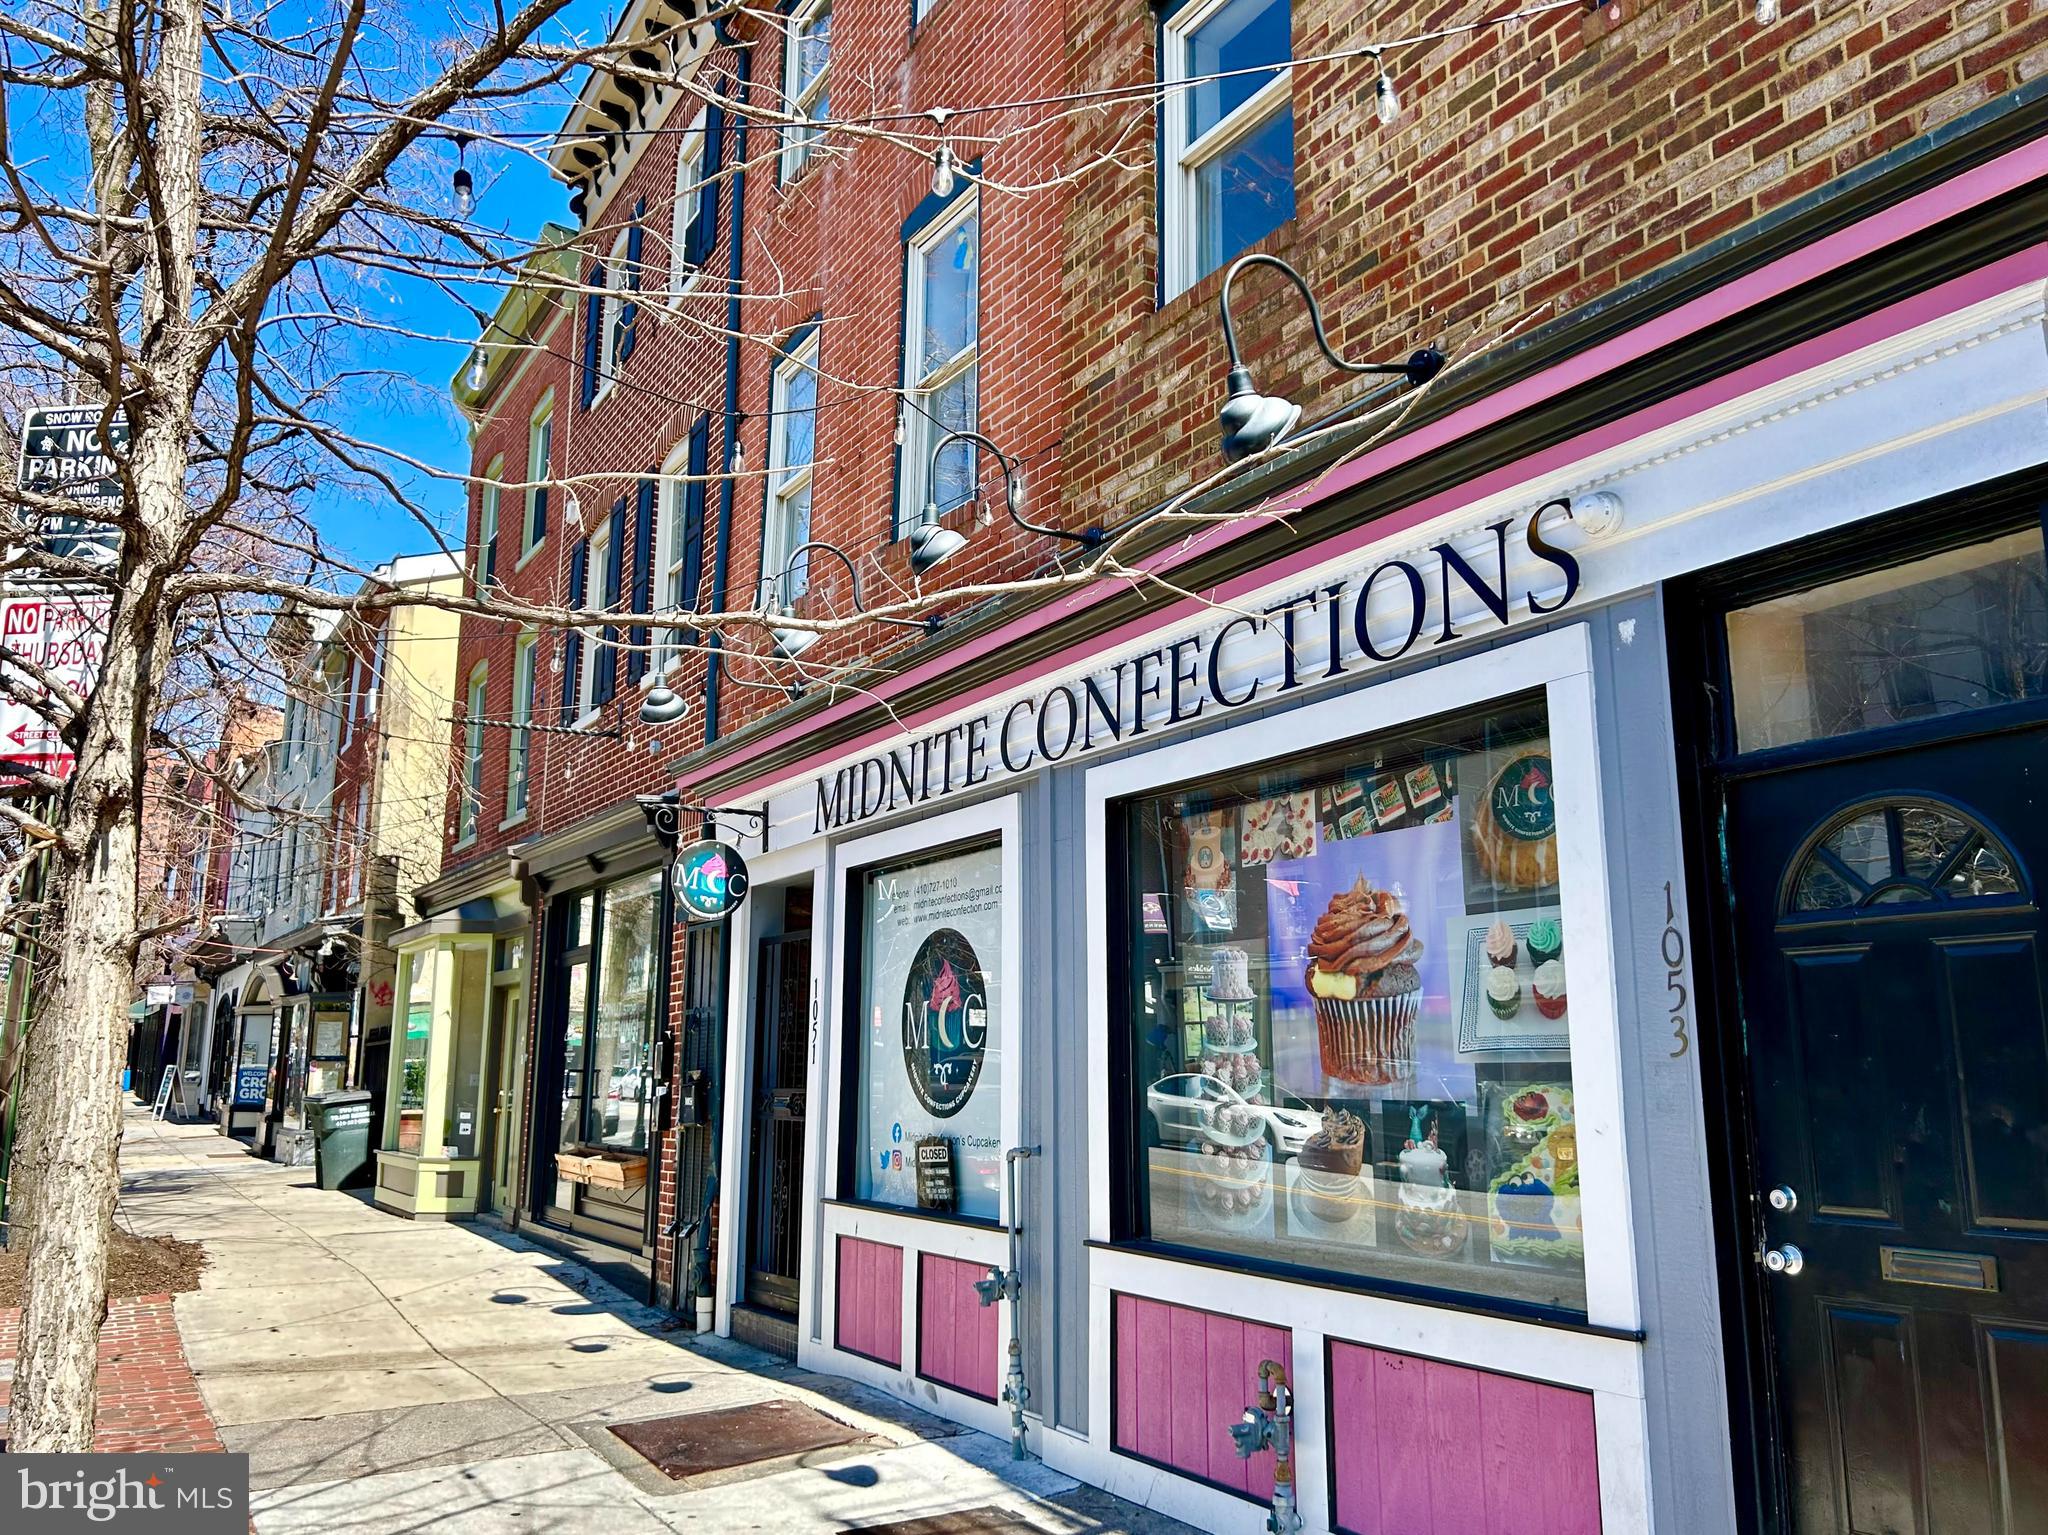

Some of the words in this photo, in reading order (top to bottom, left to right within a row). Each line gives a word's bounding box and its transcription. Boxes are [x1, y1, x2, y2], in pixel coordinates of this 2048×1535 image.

[45, 411, 83, 425] SNOW
[84, 409, 128, 423] ROTE
[28, 455, 118, 480] PARKIN
[8, 607, 38, 633] NO
[812, 715, 989, 835] MIDNITE
[1000, 497, 1580, 774] CONFECTIONS
[14, 731, 44, 740] STREET
[1661, 880, 1689, 1058] 1053
[921, 1148, 947, 1160] CLOSED
